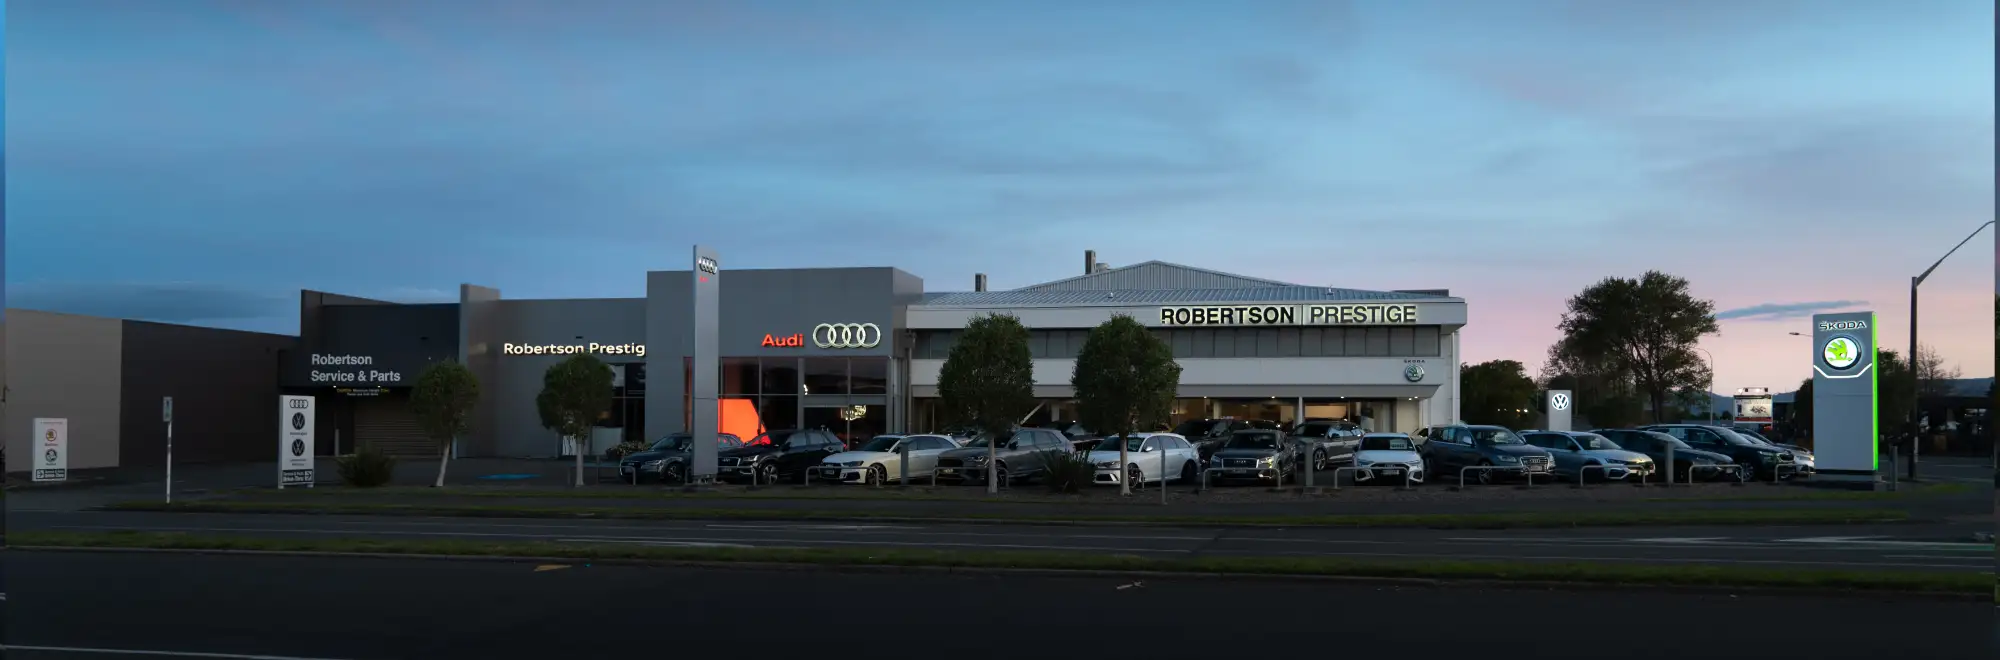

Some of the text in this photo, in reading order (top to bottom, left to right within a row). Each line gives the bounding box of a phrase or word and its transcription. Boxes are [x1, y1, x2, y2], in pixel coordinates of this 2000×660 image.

[1161, 306, 1417, 324] ROBERTSON PRESTIGE
[761, 333, 805, 347] Audi
[503, 342, 584, 354] Robertson
[311, 353, 372, 366] Robertson
[310, 369, 401, 382] Service & Parts
